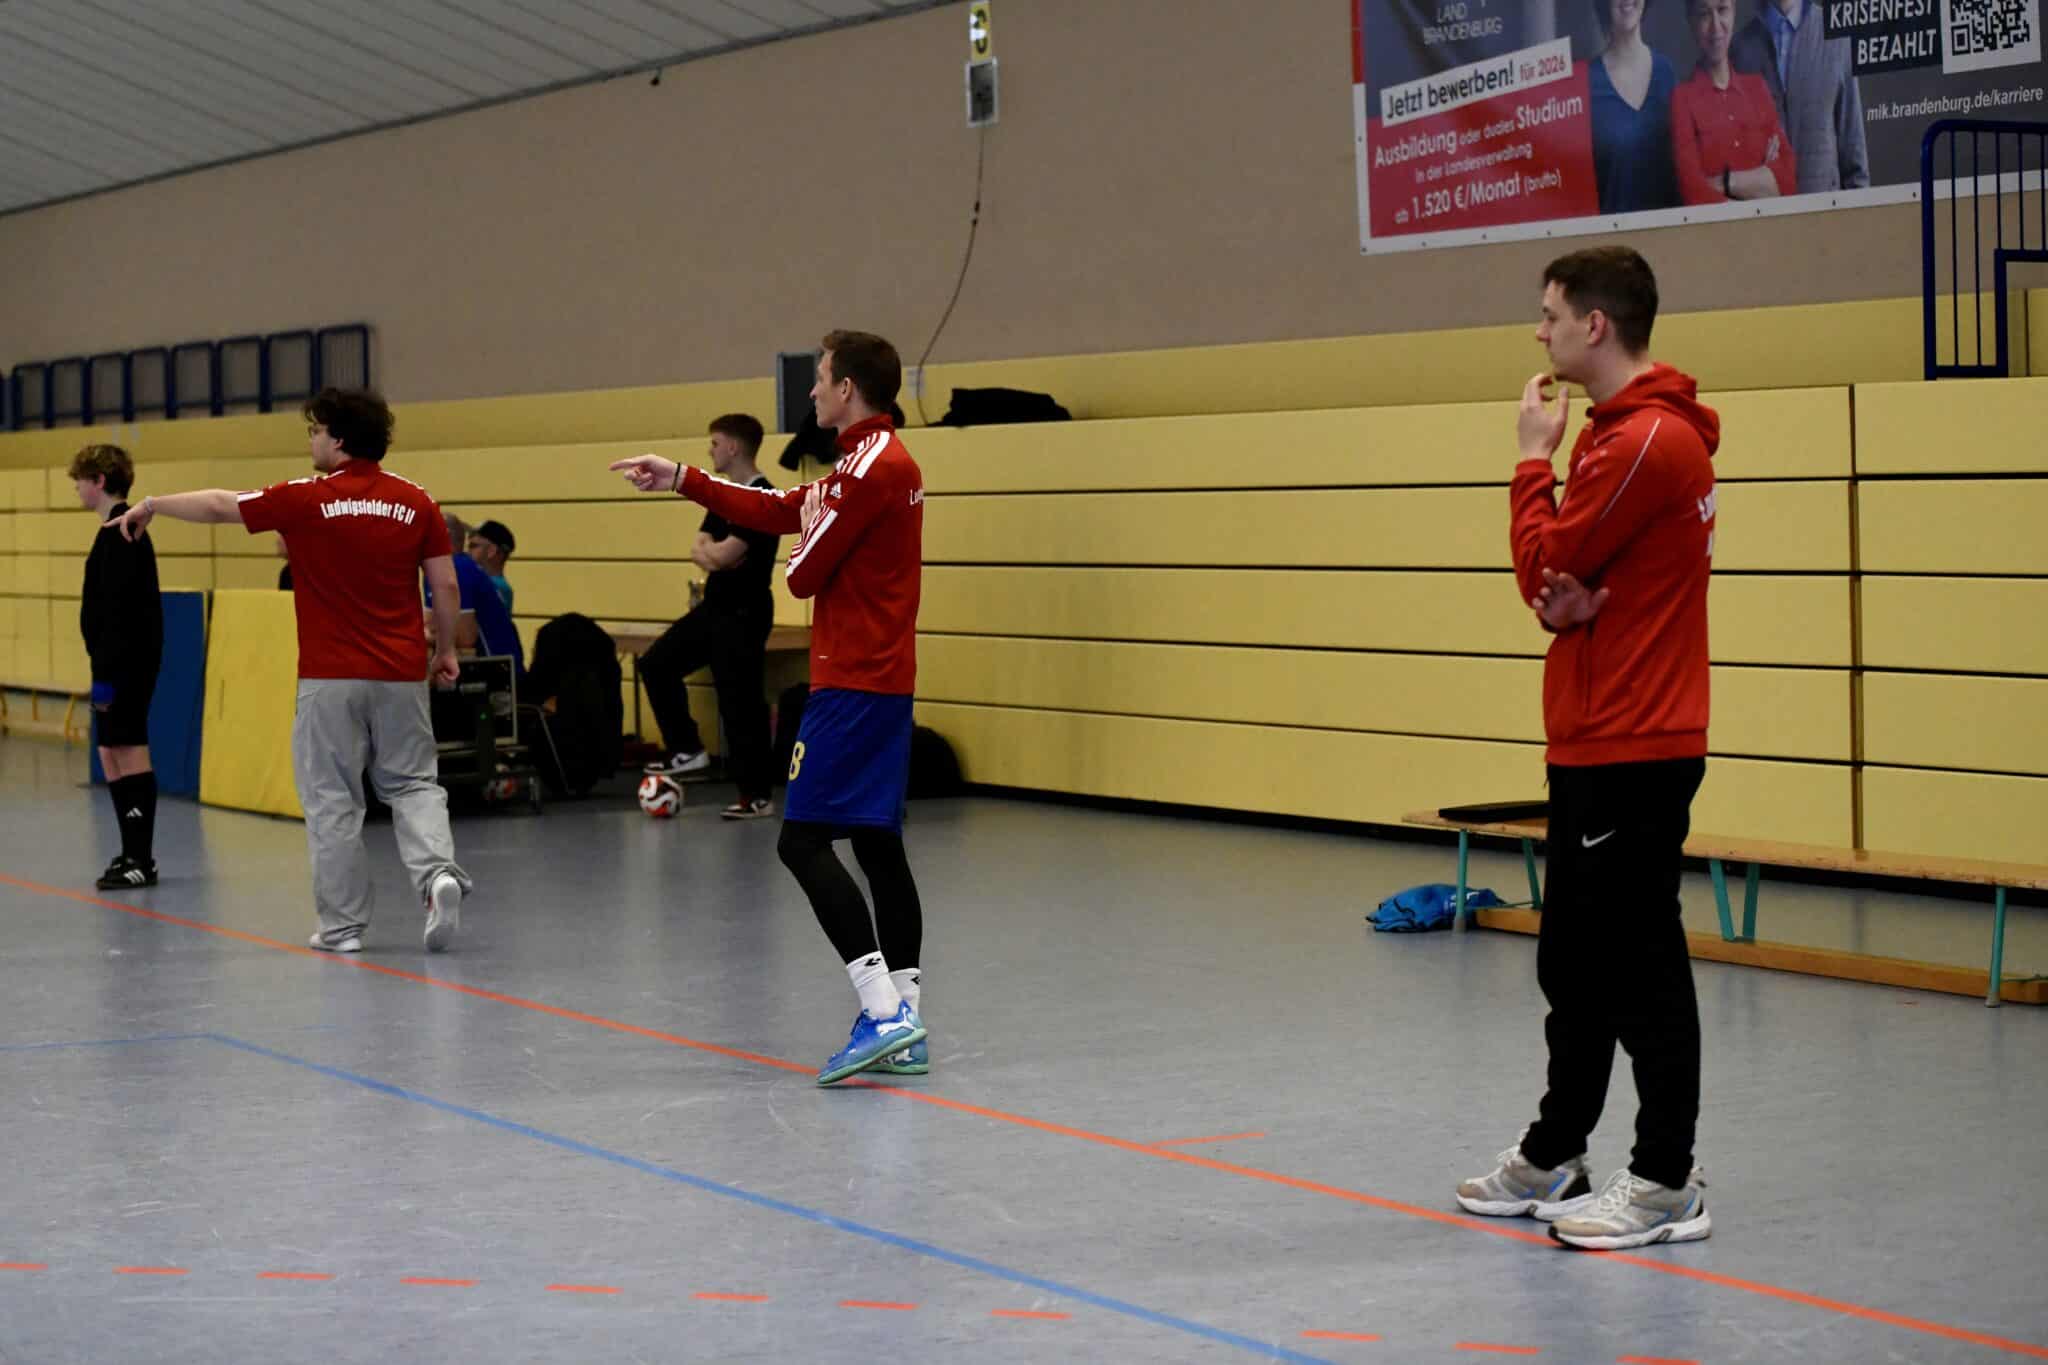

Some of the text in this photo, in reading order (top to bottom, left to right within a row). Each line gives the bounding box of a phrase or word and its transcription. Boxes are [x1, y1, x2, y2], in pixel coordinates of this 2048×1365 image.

[1423, 16, 1503, 45] BRANDENBURG
[1437, 3, 1467, 23] LAND
[1857, 28, 1937, 65] BEZAHLT
[1387, 55, 1567, 119] Jetzt bewerben! für 2026
[1867, 85, 2044, 121] mik.brandenburg.de/karriere
[1374, 95, 1583, 168] Ausbildung oder duales Studium
[1415, 143, 1533, 184] in der Landesverwaltung
[1395, 168, 1562, 224] ab 1.520 €/Monat (brutto)
[320, 498, 393, 519] Ludwigsfelder
[392, 503, 407, 522] FC
